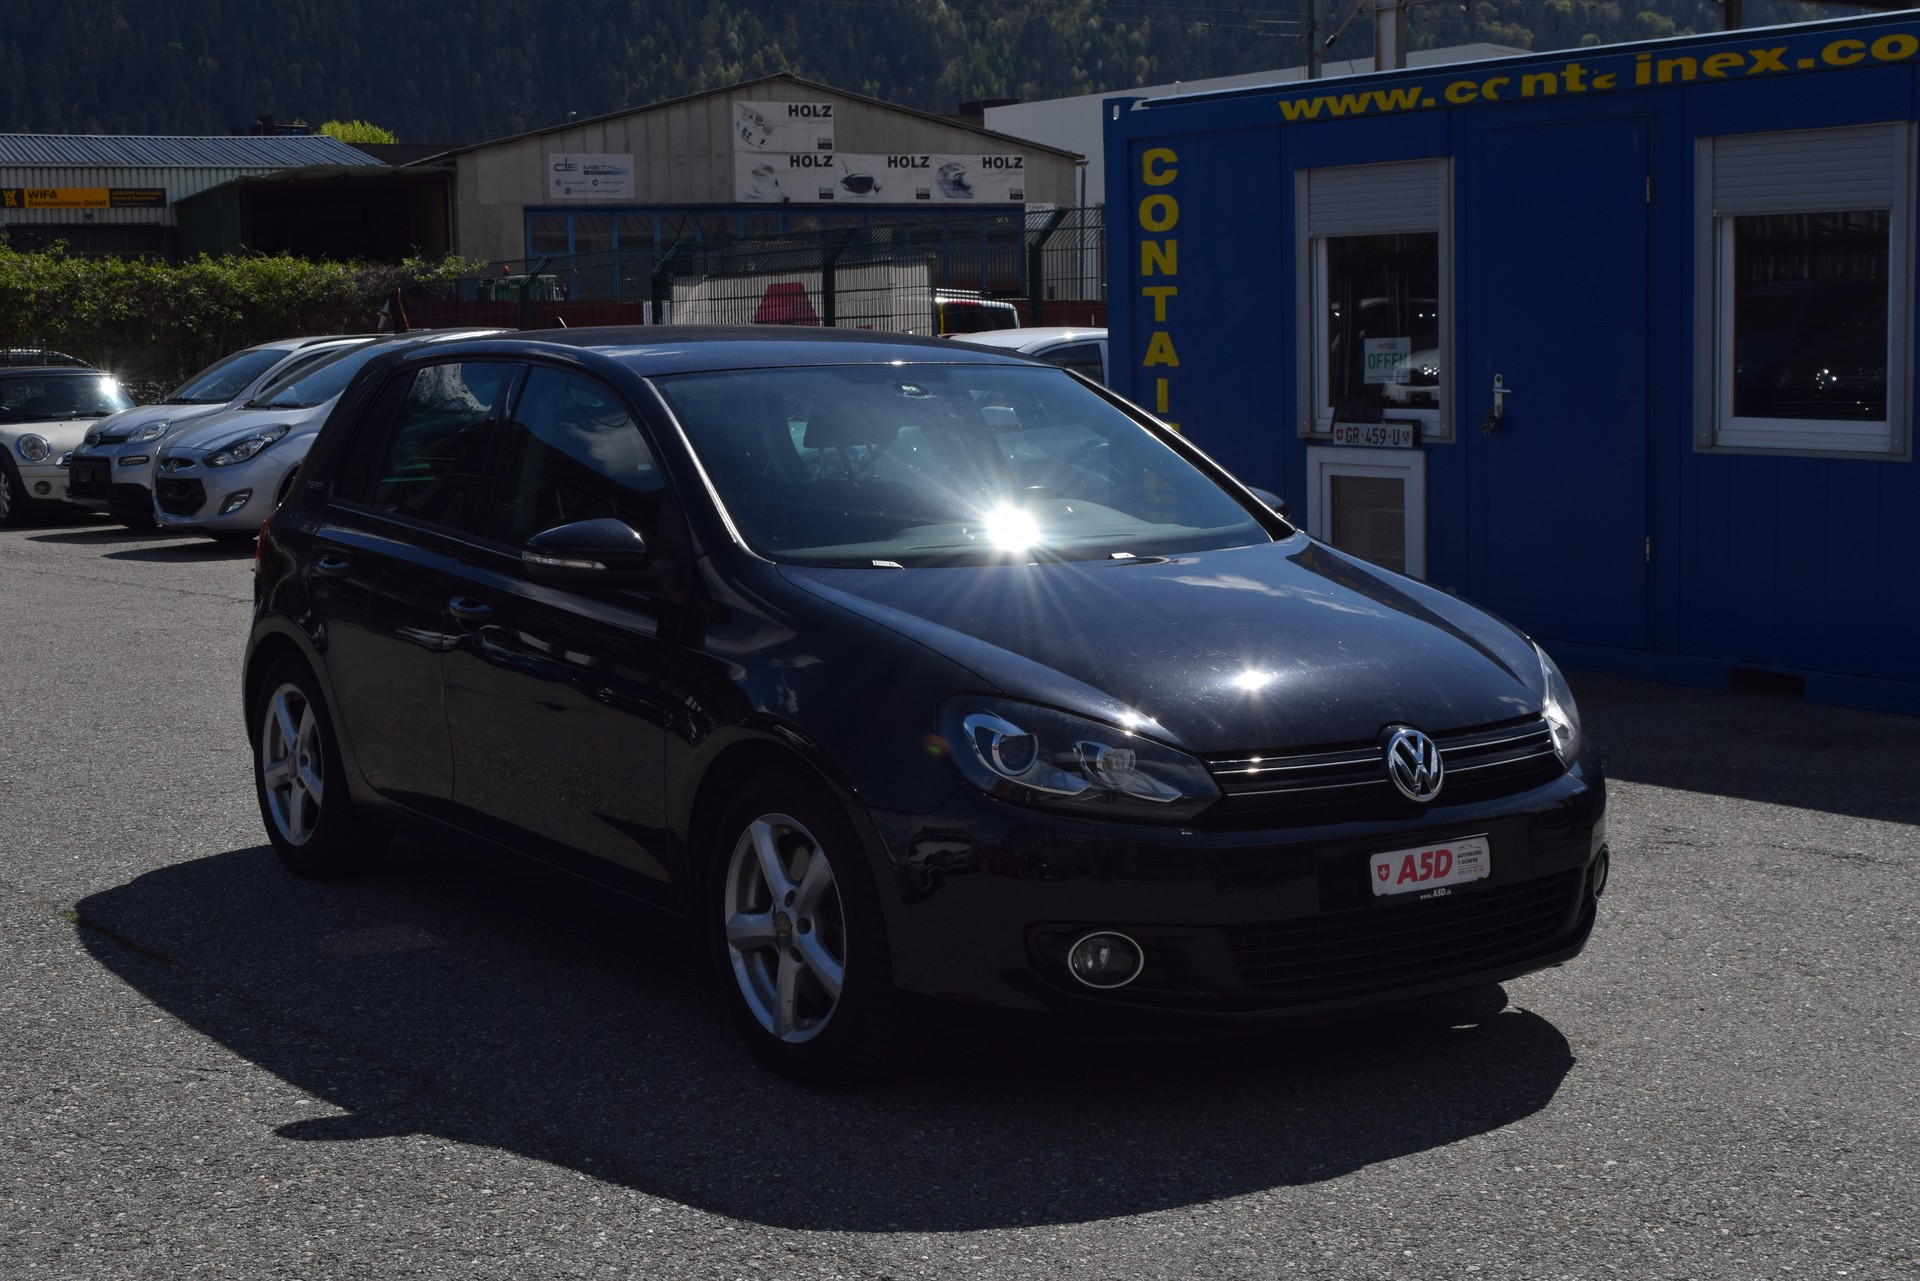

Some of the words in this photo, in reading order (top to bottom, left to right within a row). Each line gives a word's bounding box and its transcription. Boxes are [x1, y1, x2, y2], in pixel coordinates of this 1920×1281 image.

[788, 104, 832, 118] HOLZ
[790, 154, 834, 168] HOLZ
[887, 155, 931, 169] HOLZ
[982, 156, 1024, 170] HOLZ
[27, 190, 58, 199] WIFA
[83, 199, 107, 207] GmbH
[1368, 352, 1408, 370] OFFEN
[1396, 849, 1453, 885] A5D
